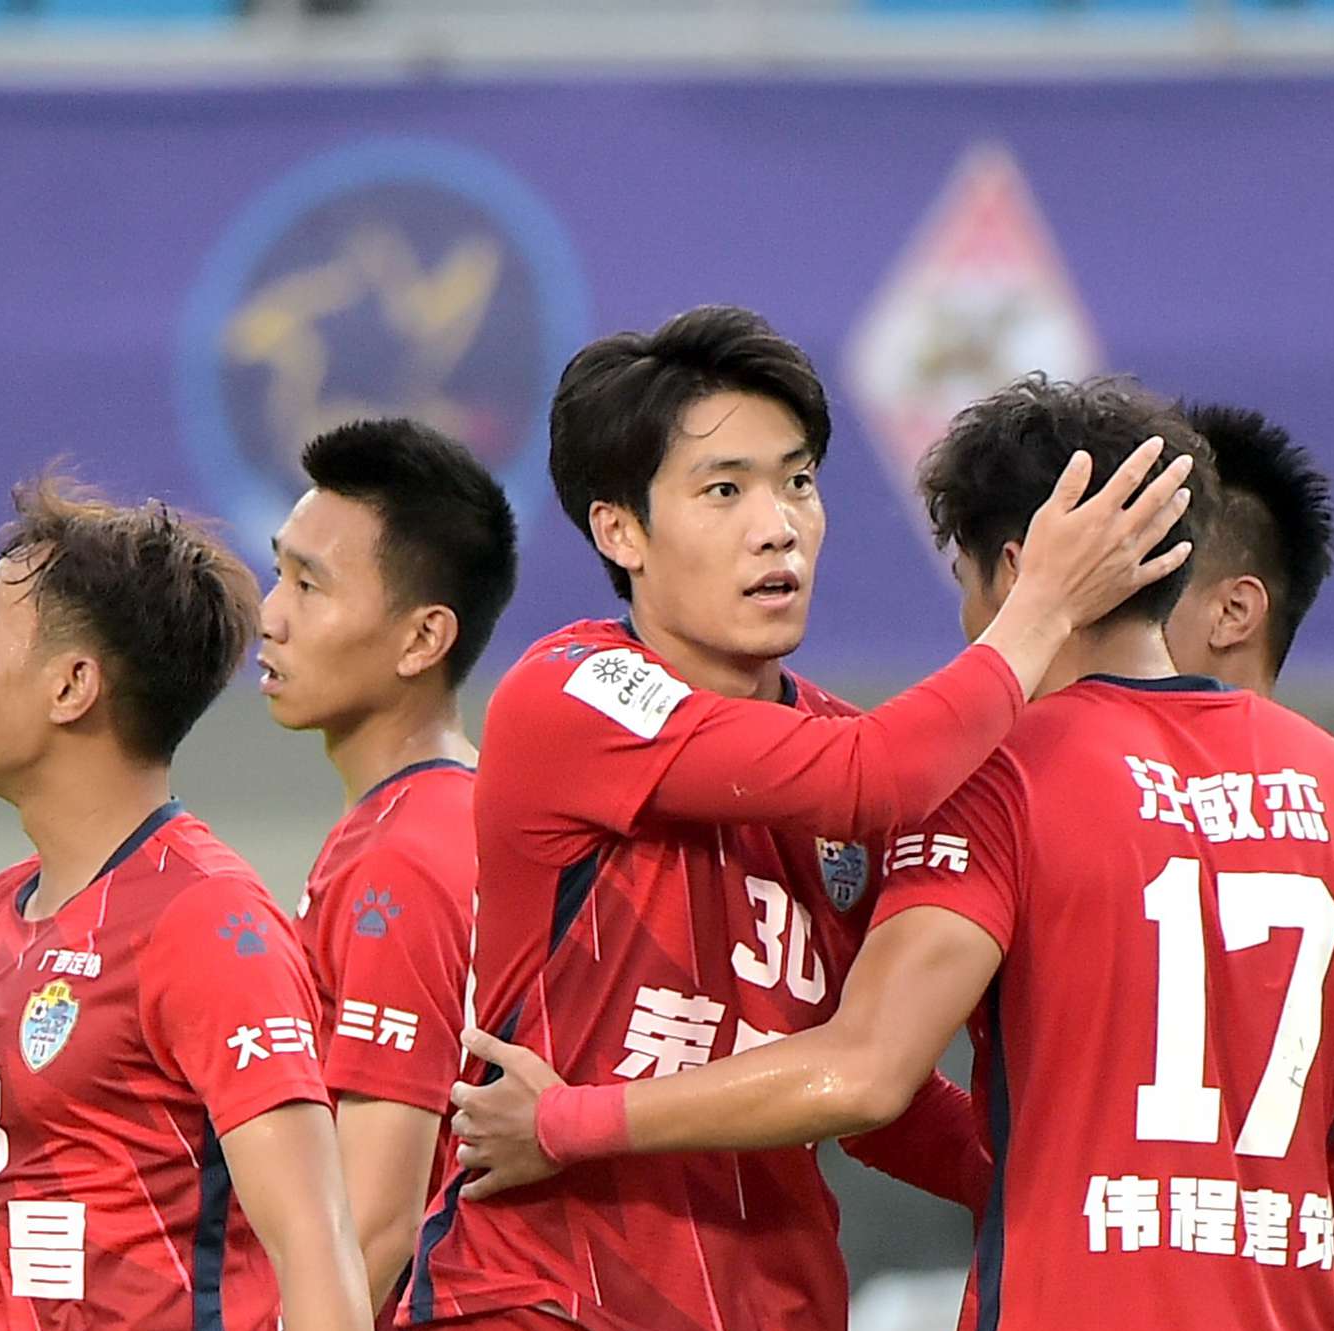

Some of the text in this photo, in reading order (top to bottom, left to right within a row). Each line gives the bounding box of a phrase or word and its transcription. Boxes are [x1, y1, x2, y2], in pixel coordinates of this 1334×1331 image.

[618, 667, 650, 705] CMCL
[1124, 755, 1330, 843] 汪敏杰
[882, 833, 969, 877] 三元
[336, 998, 419, 1052] 三元
[611, 985, 789, 1080] 荣
